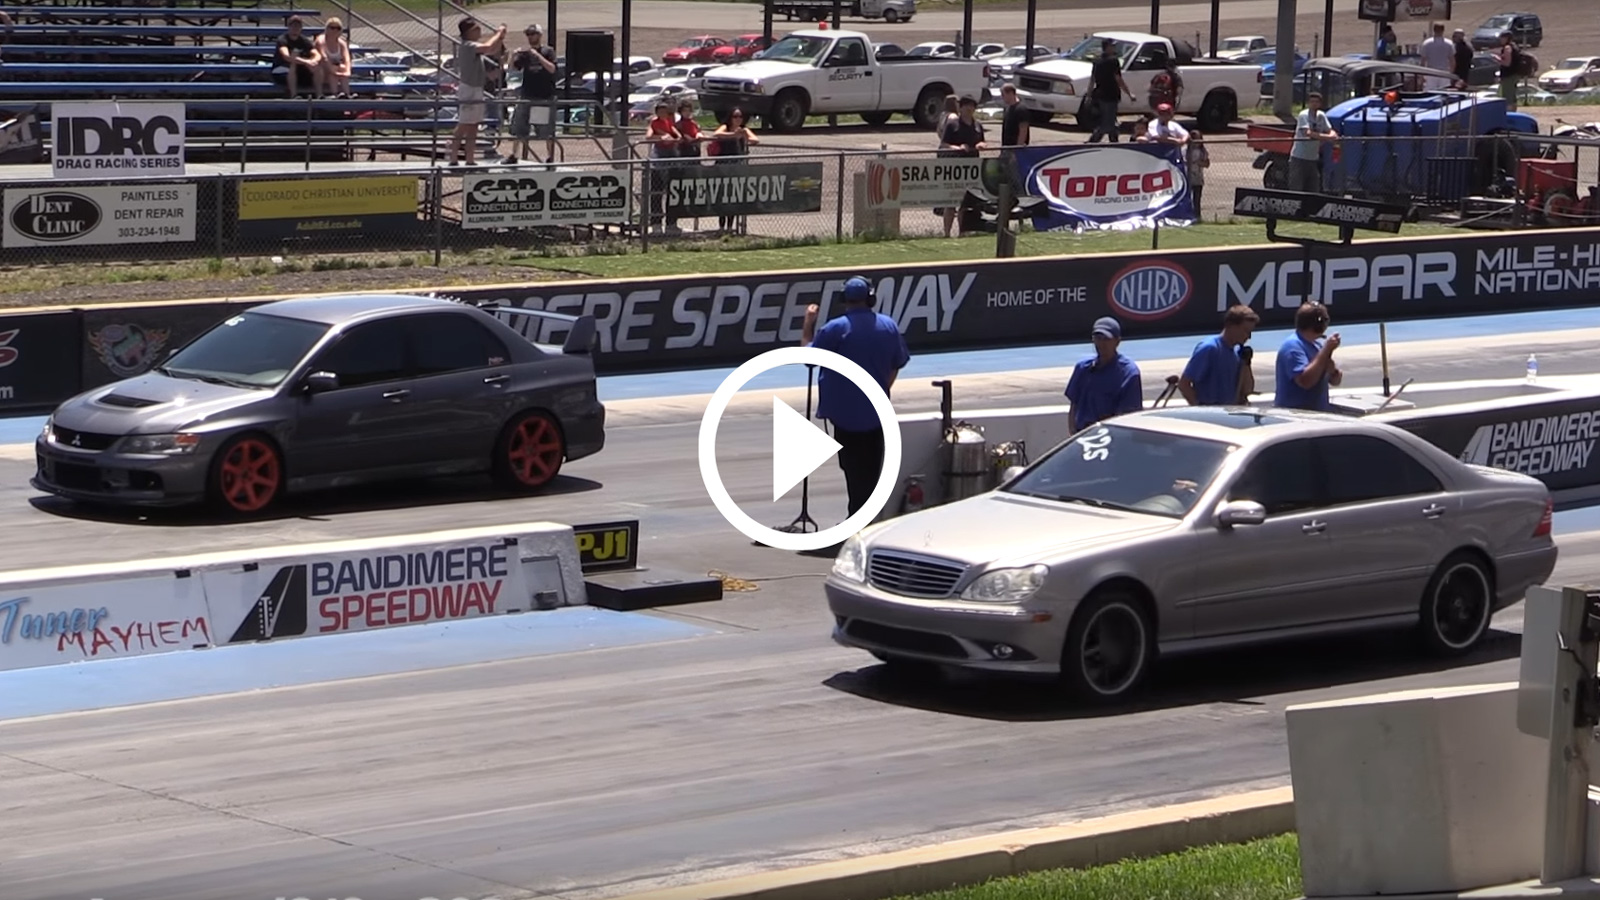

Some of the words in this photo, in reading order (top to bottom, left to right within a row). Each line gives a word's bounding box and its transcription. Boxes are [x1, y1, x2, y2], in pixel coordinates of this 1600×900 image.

[57, 115, 180, 156] IDRC
[56, 158, 92, 169] DRAG
[95, 158, 138, 168] RACING
[140, 157, 180, 168] SERIES
[901, 166, 930, 182] SRA
[933, 164, 980, 181] PHOTO
[121, 190, 179, 201] PAINTLESS
[246, 189, 300, 202] COLORADO
[302, 187, 355, 200] CHRISTIAN
[357, 184, 413, 198] UNIVERSITY
[472, 178, 538, 203] GRP
[555, 175, 619, 200] GRP
[668, 175, 787, 207] STEVINSON
[1042, 168, 1173, 199] Torco
[469, 203, 517, 212] CONNECTING
[519, 201, 542, 211] RODS
[551, 200, 600, 209] CONNECTING
[601, 198, 625, 208] RODS
[1094, 197, 1121, 205] RACING
[1122, 196, 1140, 204] OILS
[114, 209, 142, 219] DENT
[145, 208, 184, 219] REPAIR
[467, 215, 505, 224] ALUMINUM
[511, 213, 542, 221] TITANIUM
[550, 212, 587, 221] ALUMINUM
[593, 210, 624, 219] TITANIUM
[117, 226, 180, 237] 303-234-1948
[1120, 270, 1182, 310] NHRA
[1217, 251, 1457, 312] MOPAR
[986, 290, 1032, 308] HOME
[1034, 289, 1055, 305] OF
[1057, 286, 1087, 303] THE
[485, 289, 662, 353] MERE
[1491, 410, 1600, 453] BANDIMERE
[1492, 439, 1596, 476] SPEEDWAY
[573, 530, 628, 560] PJ1
[311, 544, 508, 596] BANDIMERE
[319, 579, 503, 633] SPEEDWAY
[0, 596, 109, 645] Tuner
[57, 616, 211, 657] MAYHEM
